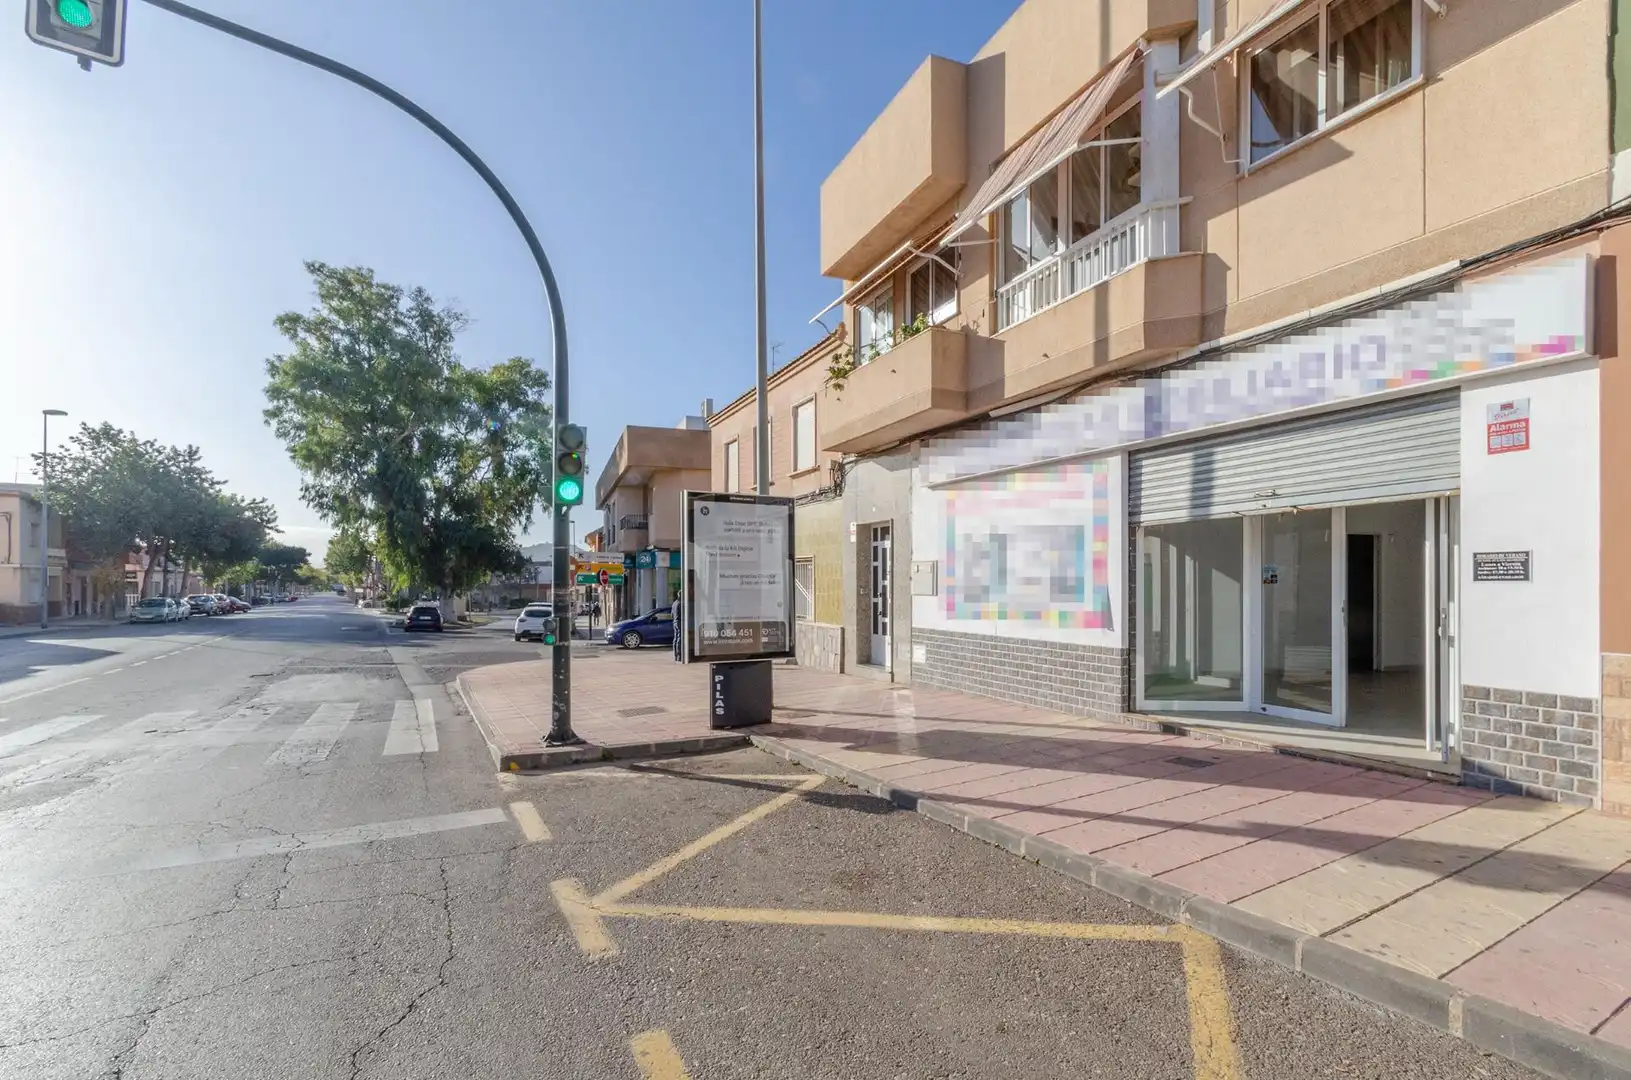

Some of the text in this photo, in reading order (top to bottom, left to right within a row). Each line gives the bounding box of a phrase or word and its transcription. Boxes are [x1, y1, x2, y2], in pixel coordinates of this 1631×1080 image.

[1490, 421, 1526, 432] Alarma
[738, 628, 753, 637] 451
[714, 675, 725, 715] PILAS
